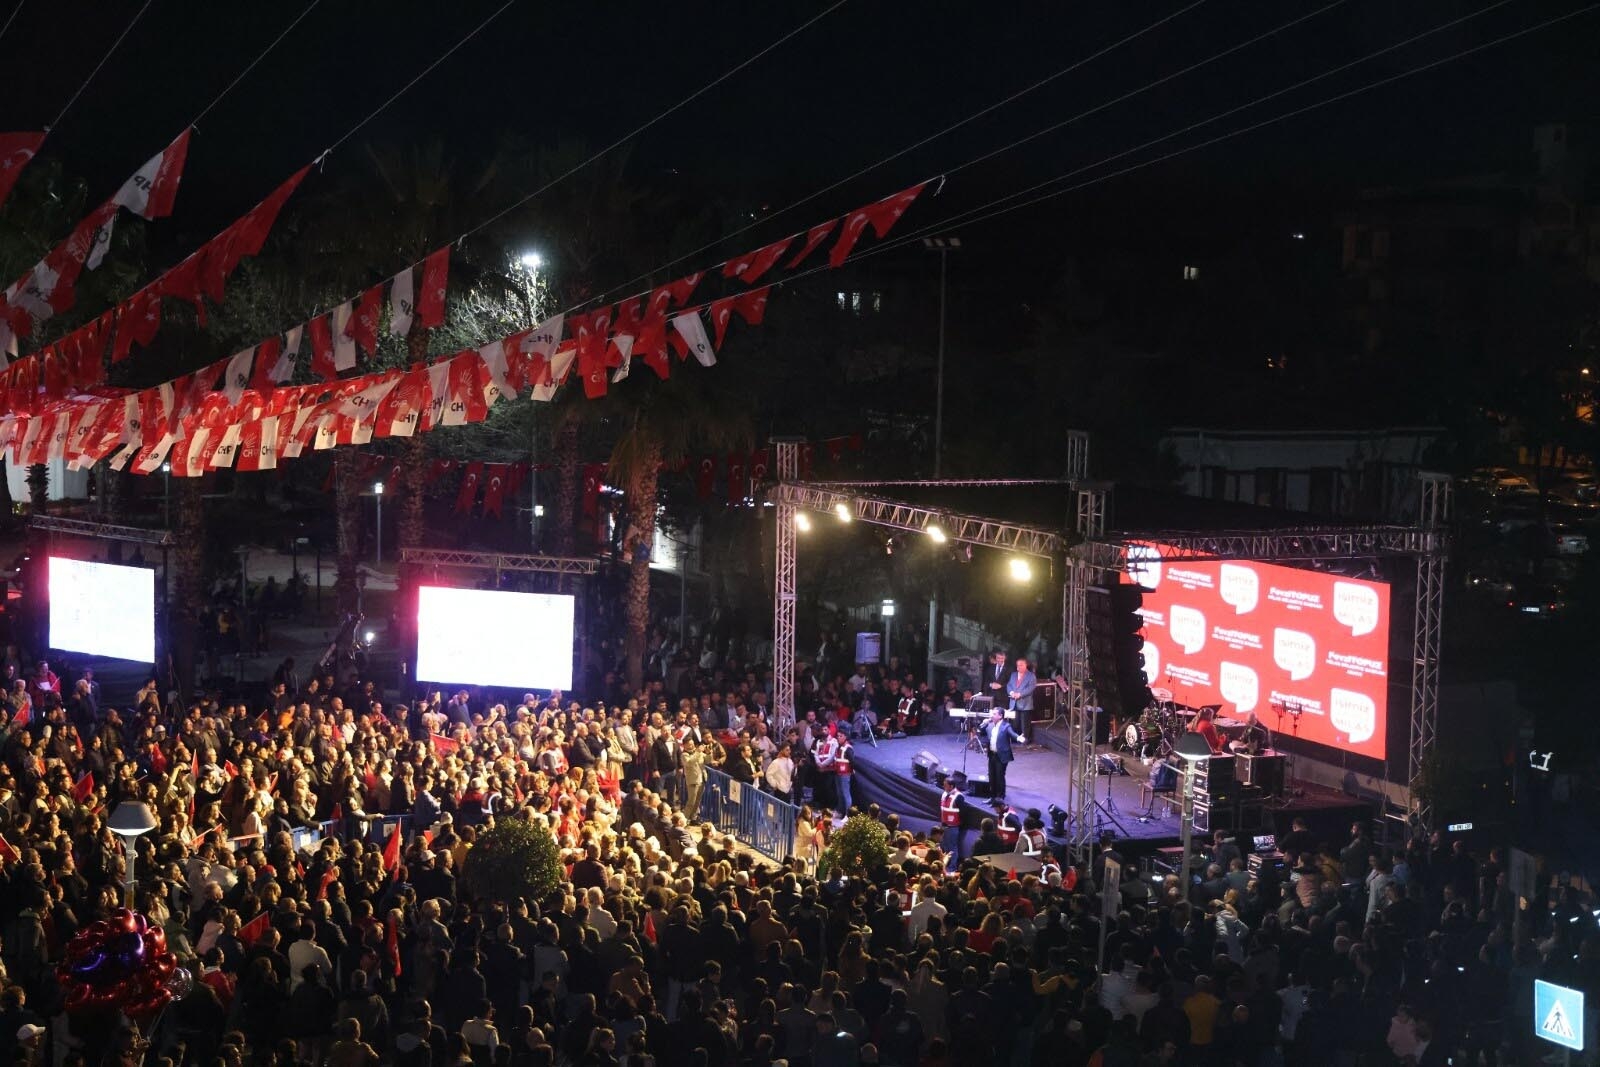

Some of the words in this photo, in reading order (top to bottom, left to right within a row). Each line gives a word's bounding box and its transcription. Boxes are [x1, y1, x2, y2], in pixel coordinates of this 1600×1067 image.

[489, 386, 500, 395] CH
[451, 402, 464, 412] CH
[242, 449, 253, 458] CH
